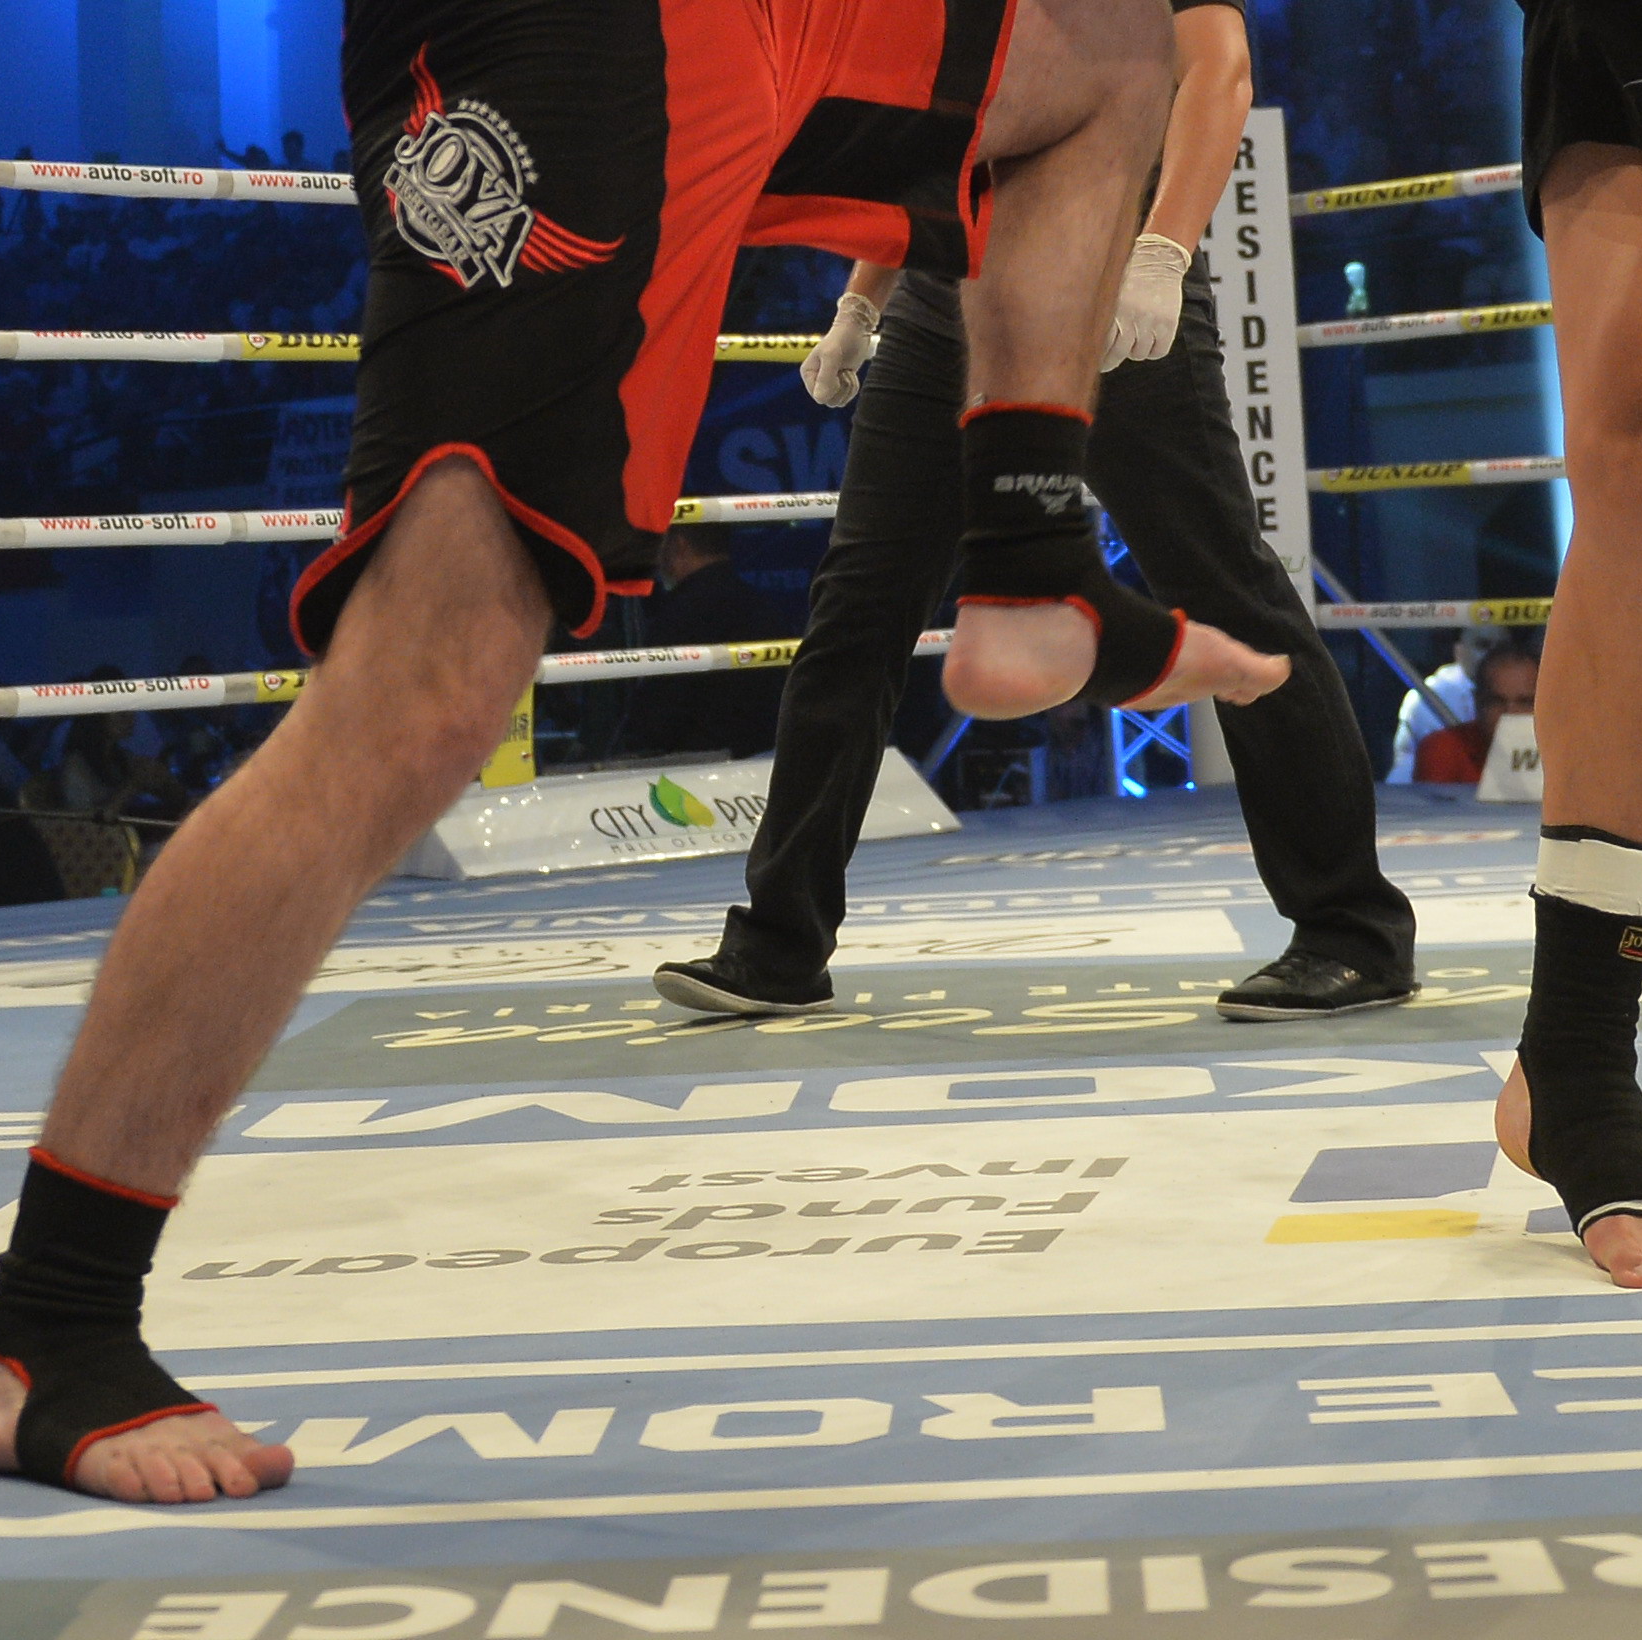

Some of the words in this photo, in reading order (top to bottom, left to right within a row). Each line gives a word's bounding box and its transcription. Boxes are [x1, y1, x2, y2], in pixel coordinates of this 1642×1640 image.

[31, 161, 205, 187] www.auto-soft.ro
[1336, 178, 1448, 211] DUNLOP
[394, 110, 534, 289] JOYA
[1233, 135, 1280, 533] RESIDENCE
[40, 512, 217, 532] www.auto-soft.ro
[590, 802, 655, 840] CITY
[627, 1154, 1129, 1196] Invest
[593, 1188, 1100, 1235] Funds
[179, 1228, 1063, 1286] European
